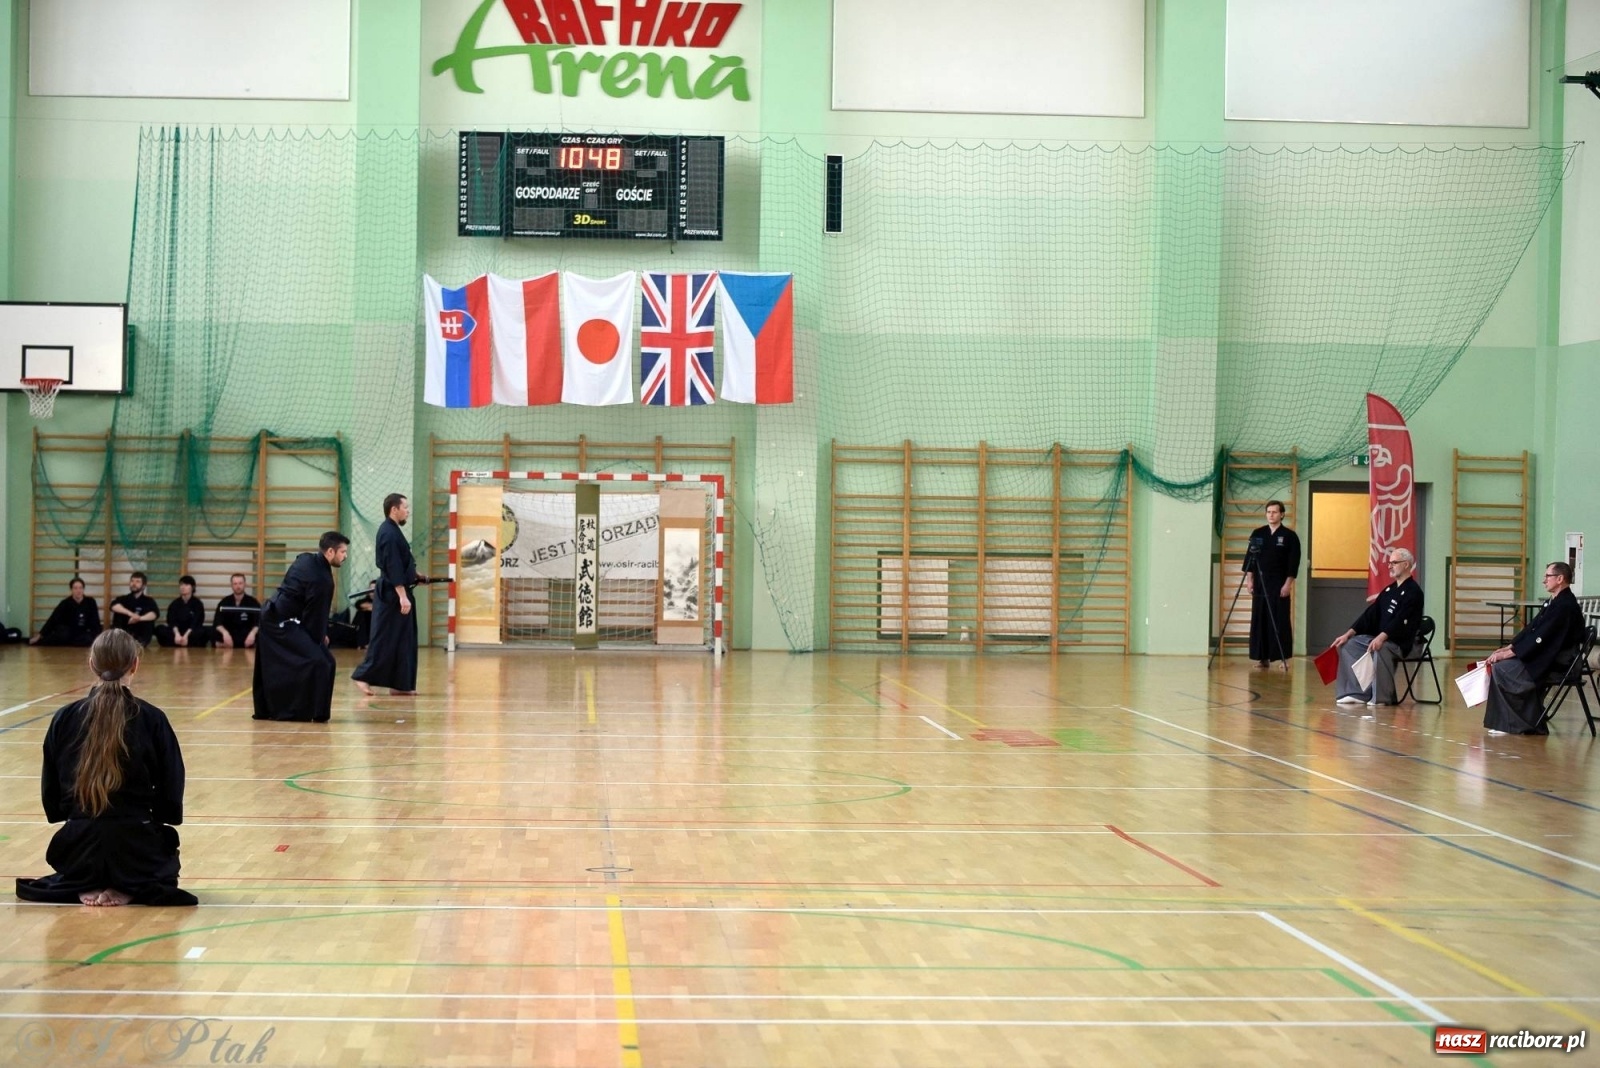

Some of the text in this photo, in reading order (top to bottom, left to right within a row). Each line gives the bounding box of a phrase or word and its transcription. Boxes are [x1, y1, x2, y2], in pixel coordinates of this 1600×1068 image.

[433, 0, 751, 101] Arena
[560, 148, 621, 170] 10 48
[515, 186, 581, 200] GOSPODARZE
[615, 186, 653, 201] GOŚCIE
[529, 541, 567, 564] JEST
